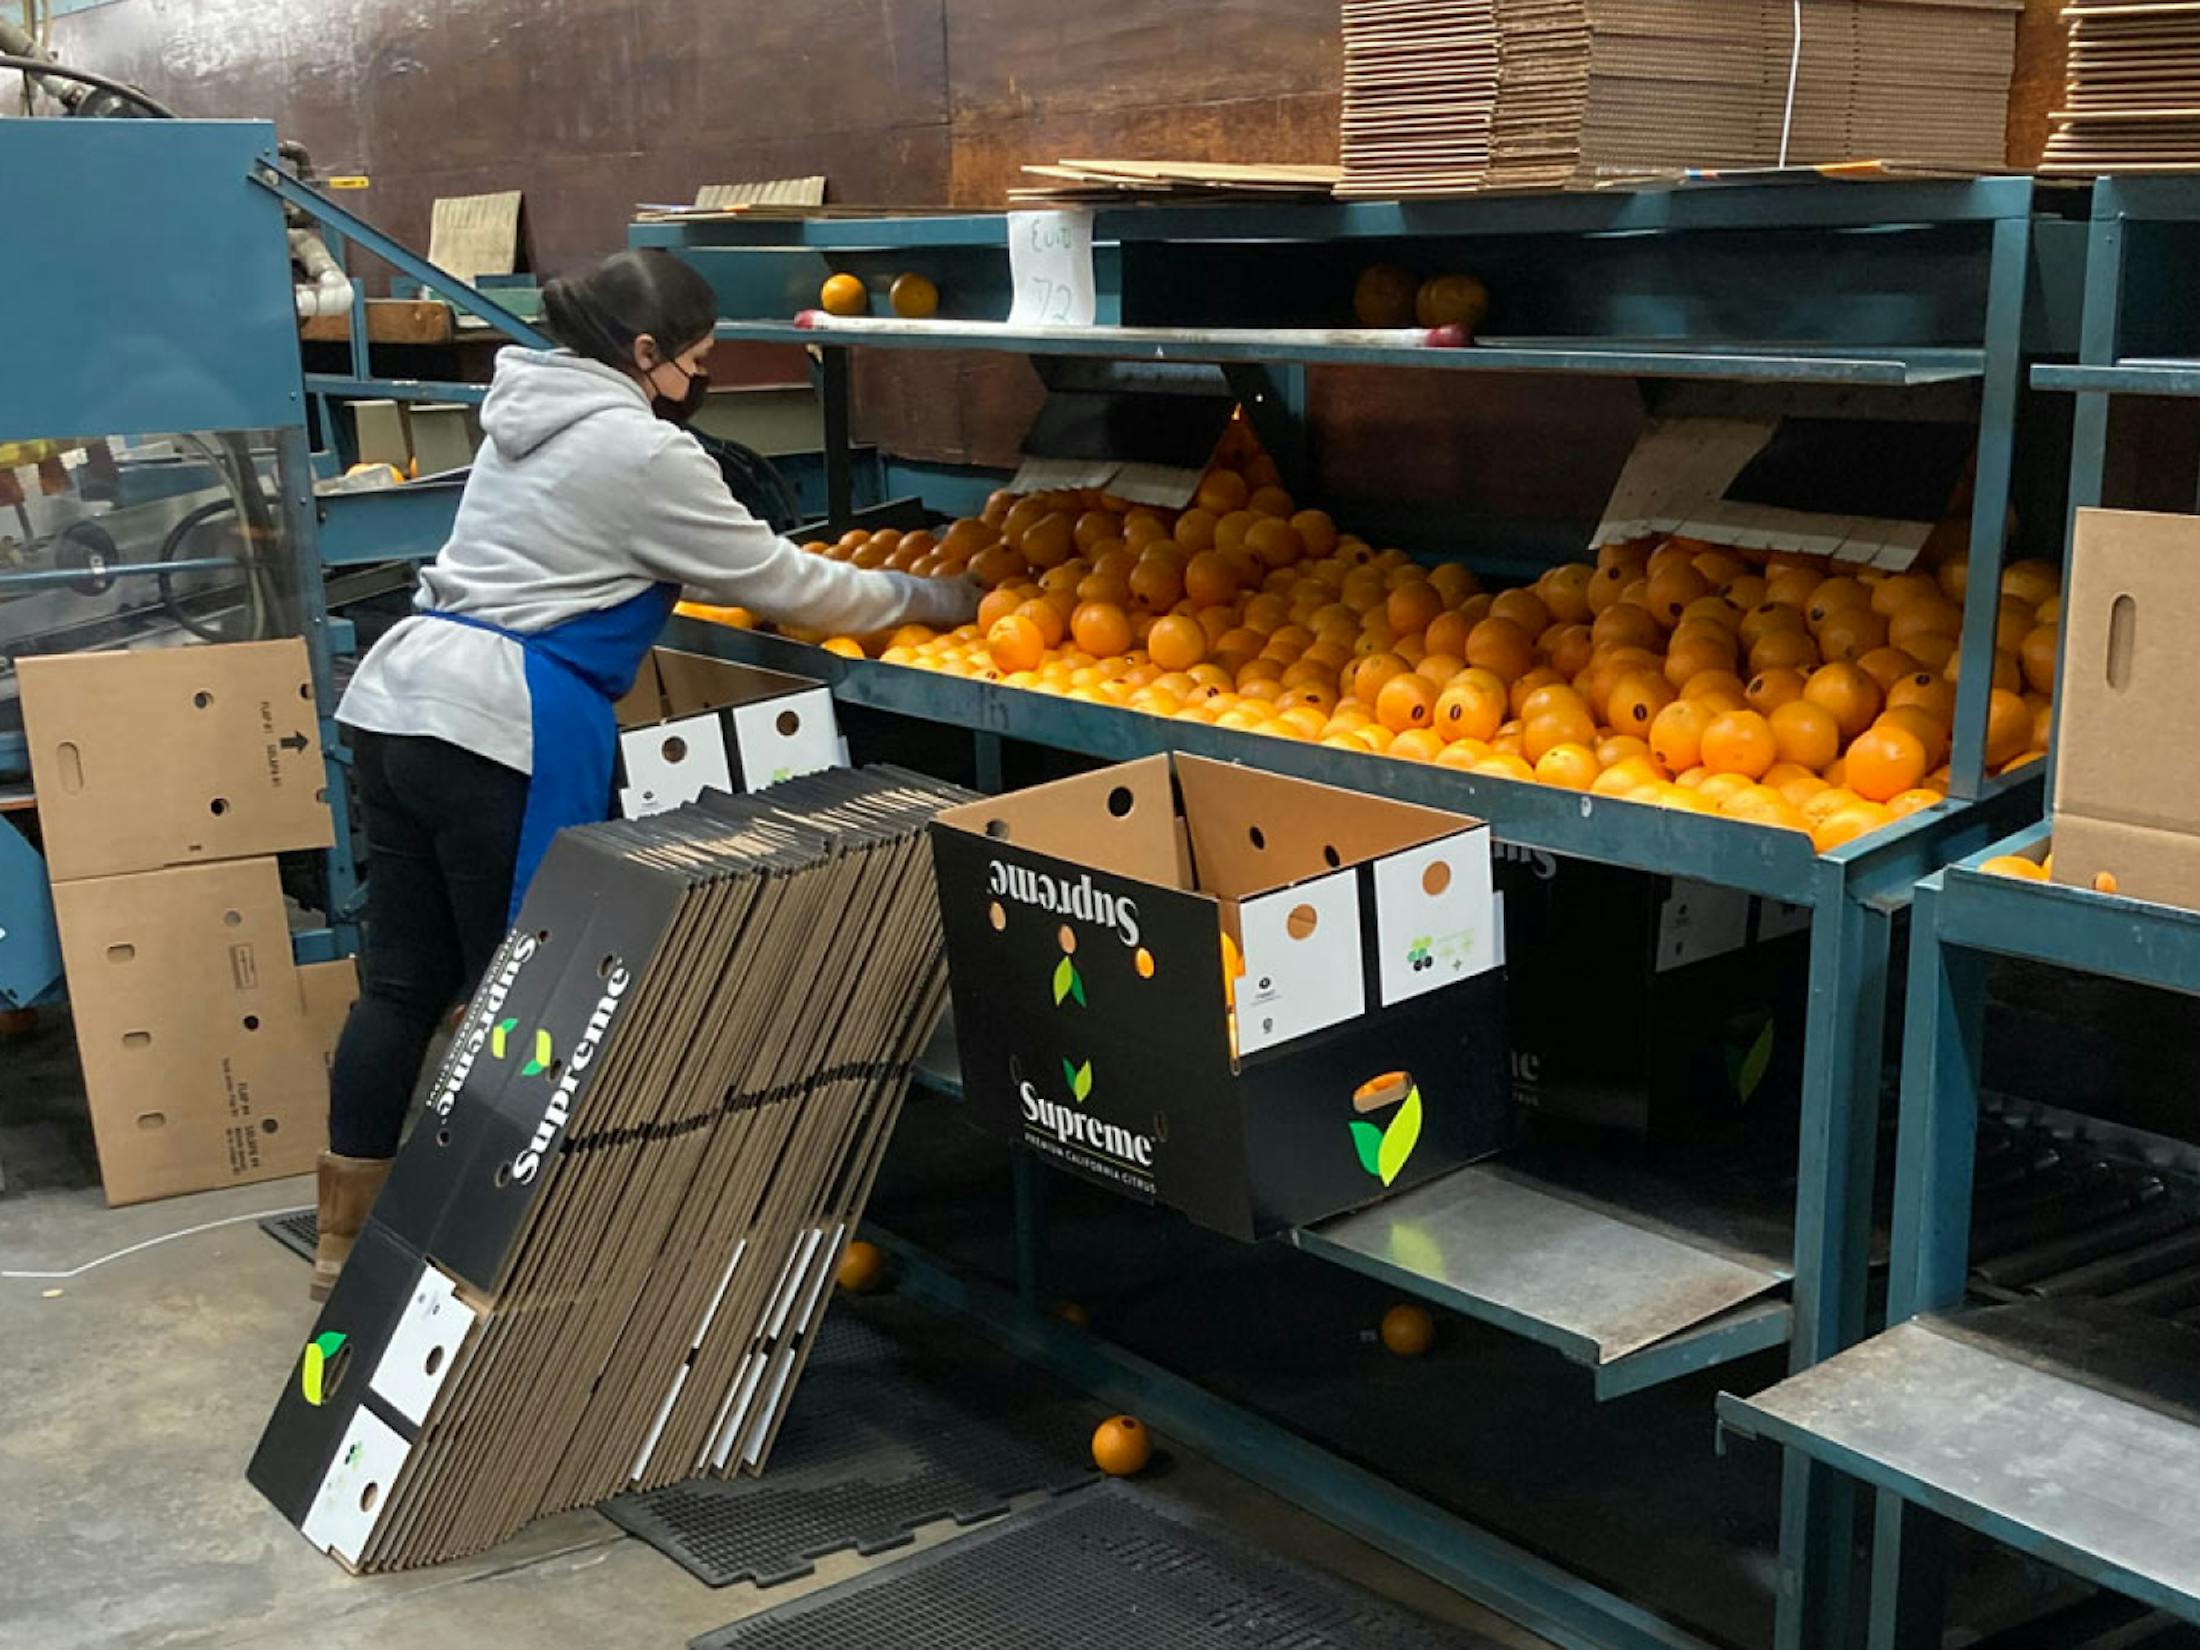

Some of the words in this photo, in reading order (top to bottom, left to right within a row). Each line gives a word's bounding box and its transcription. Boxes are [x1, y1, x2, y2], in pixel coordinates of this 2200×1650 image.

[1031, 276, 1072, 320] 72
[988, 860, 1140, 948] Supreme
[436, 934, 538, 1117] Supreme
[512, 967, 630, 1186] Supreme
[1020, 1080, 1153, 1167] Supreme
